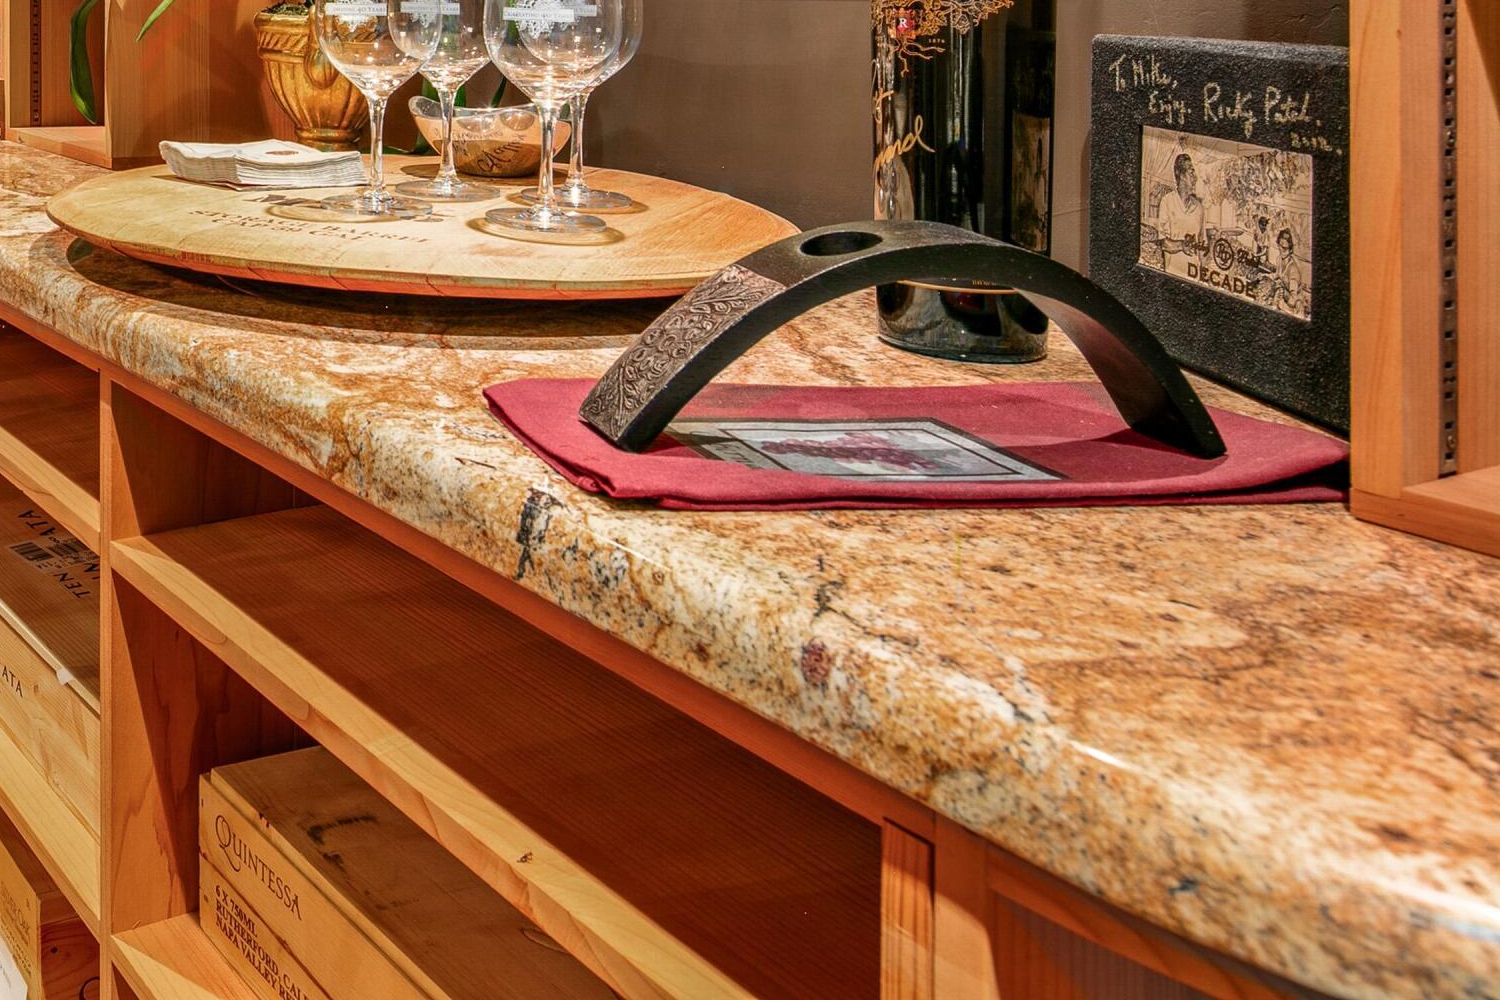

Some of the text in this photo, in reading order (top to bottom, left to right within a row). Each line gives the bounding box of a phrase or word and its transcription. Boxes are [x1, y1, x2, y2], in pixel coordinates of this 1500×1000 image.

[1187, 261, 1257, 301] DECADE
[214, 814, 302, 922] QUINTESSA
[215, 884, 258, 938] 6 X 750ML
[215, 912, 240, 950] NAPA
[240, 943, 278, 991] VALLEY
